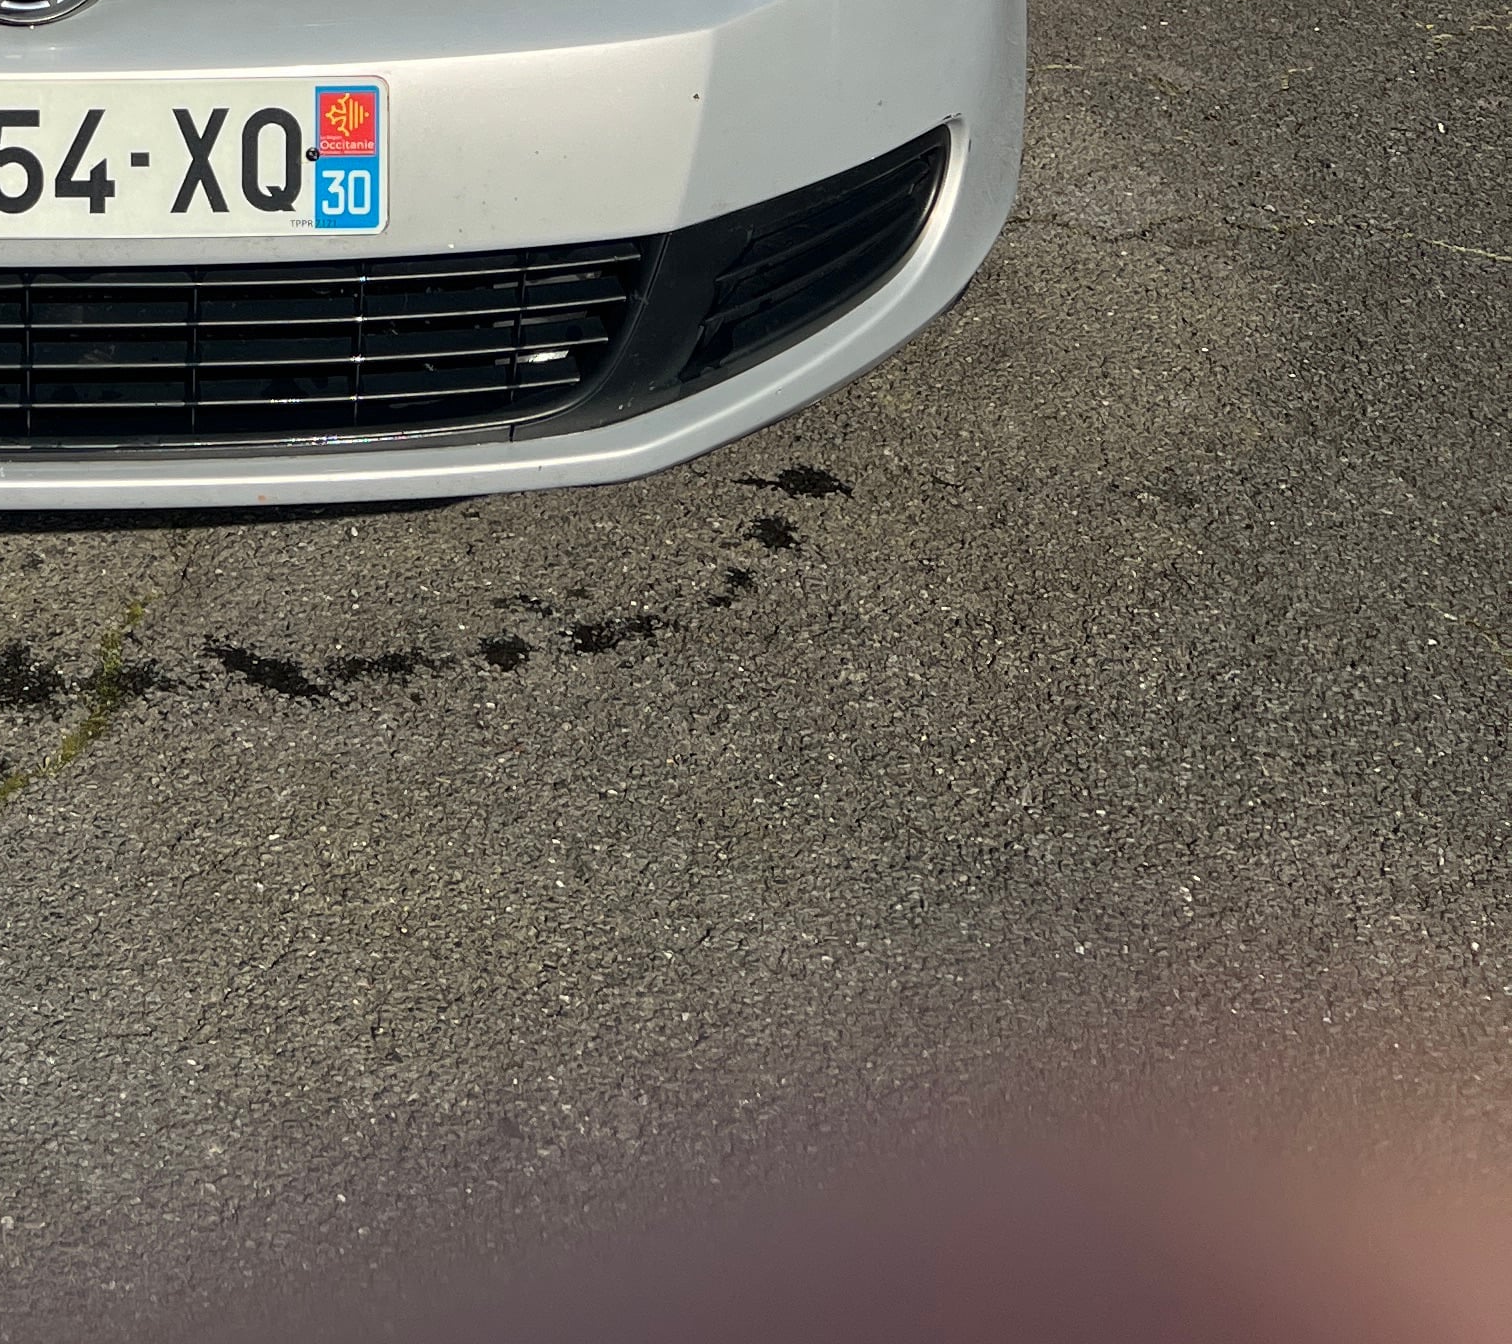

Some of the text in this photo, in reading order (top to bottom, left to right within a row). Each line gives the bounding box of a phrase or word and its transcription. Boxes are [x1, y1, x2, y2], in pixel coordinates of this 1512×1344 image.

[320, 139, 375, 150] Occitanie
[322, 169, 371, 215] 30
[290, 219, 313, 228] TPPR
